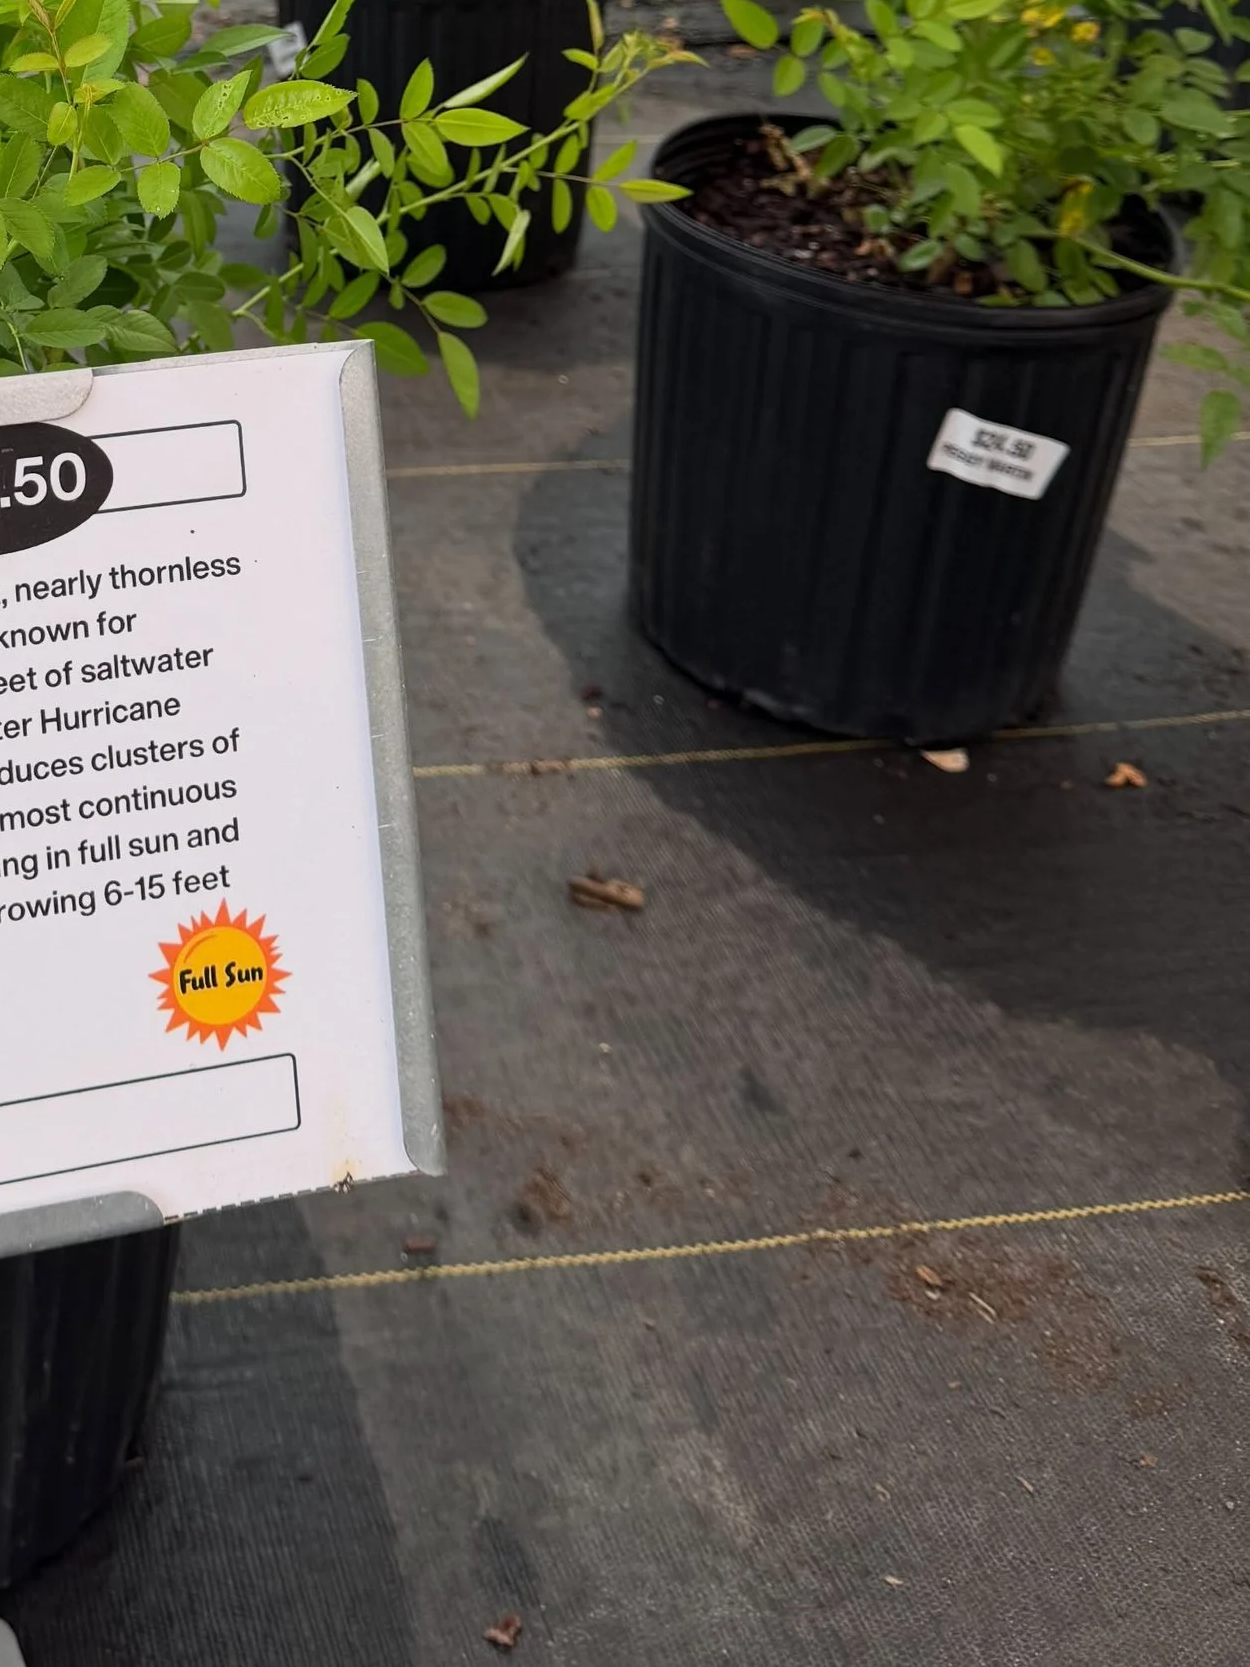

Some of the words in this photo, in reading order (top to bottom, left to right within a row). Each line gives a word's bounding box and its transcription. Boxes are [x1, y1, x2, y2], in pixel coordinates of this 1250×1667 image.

[15, 569, 103, 603] nearly
[108, 556, 241, 590] thornless
[96, 610, 137, 636] for
[44, 660, 73, 688] of
[80, 647, 214, 684] saltwater
[40, 697, 181, 735] Hurricane
[90, 738, 205, 772] clusters
[211, 726, 240, 755] of
[78, 779, 238, 820] continuous
[46, 845, 71, 871] in
[77, 834, 121, 865] full
[128, 832, 179, 857] sun
[187, 816, 240, 849] and
[103, 873, 166, 907] 6-15
[171, 865, 231, 896] feet
[179, 965, 218, 995] Full
[224, 961, 263, 988] Sun
